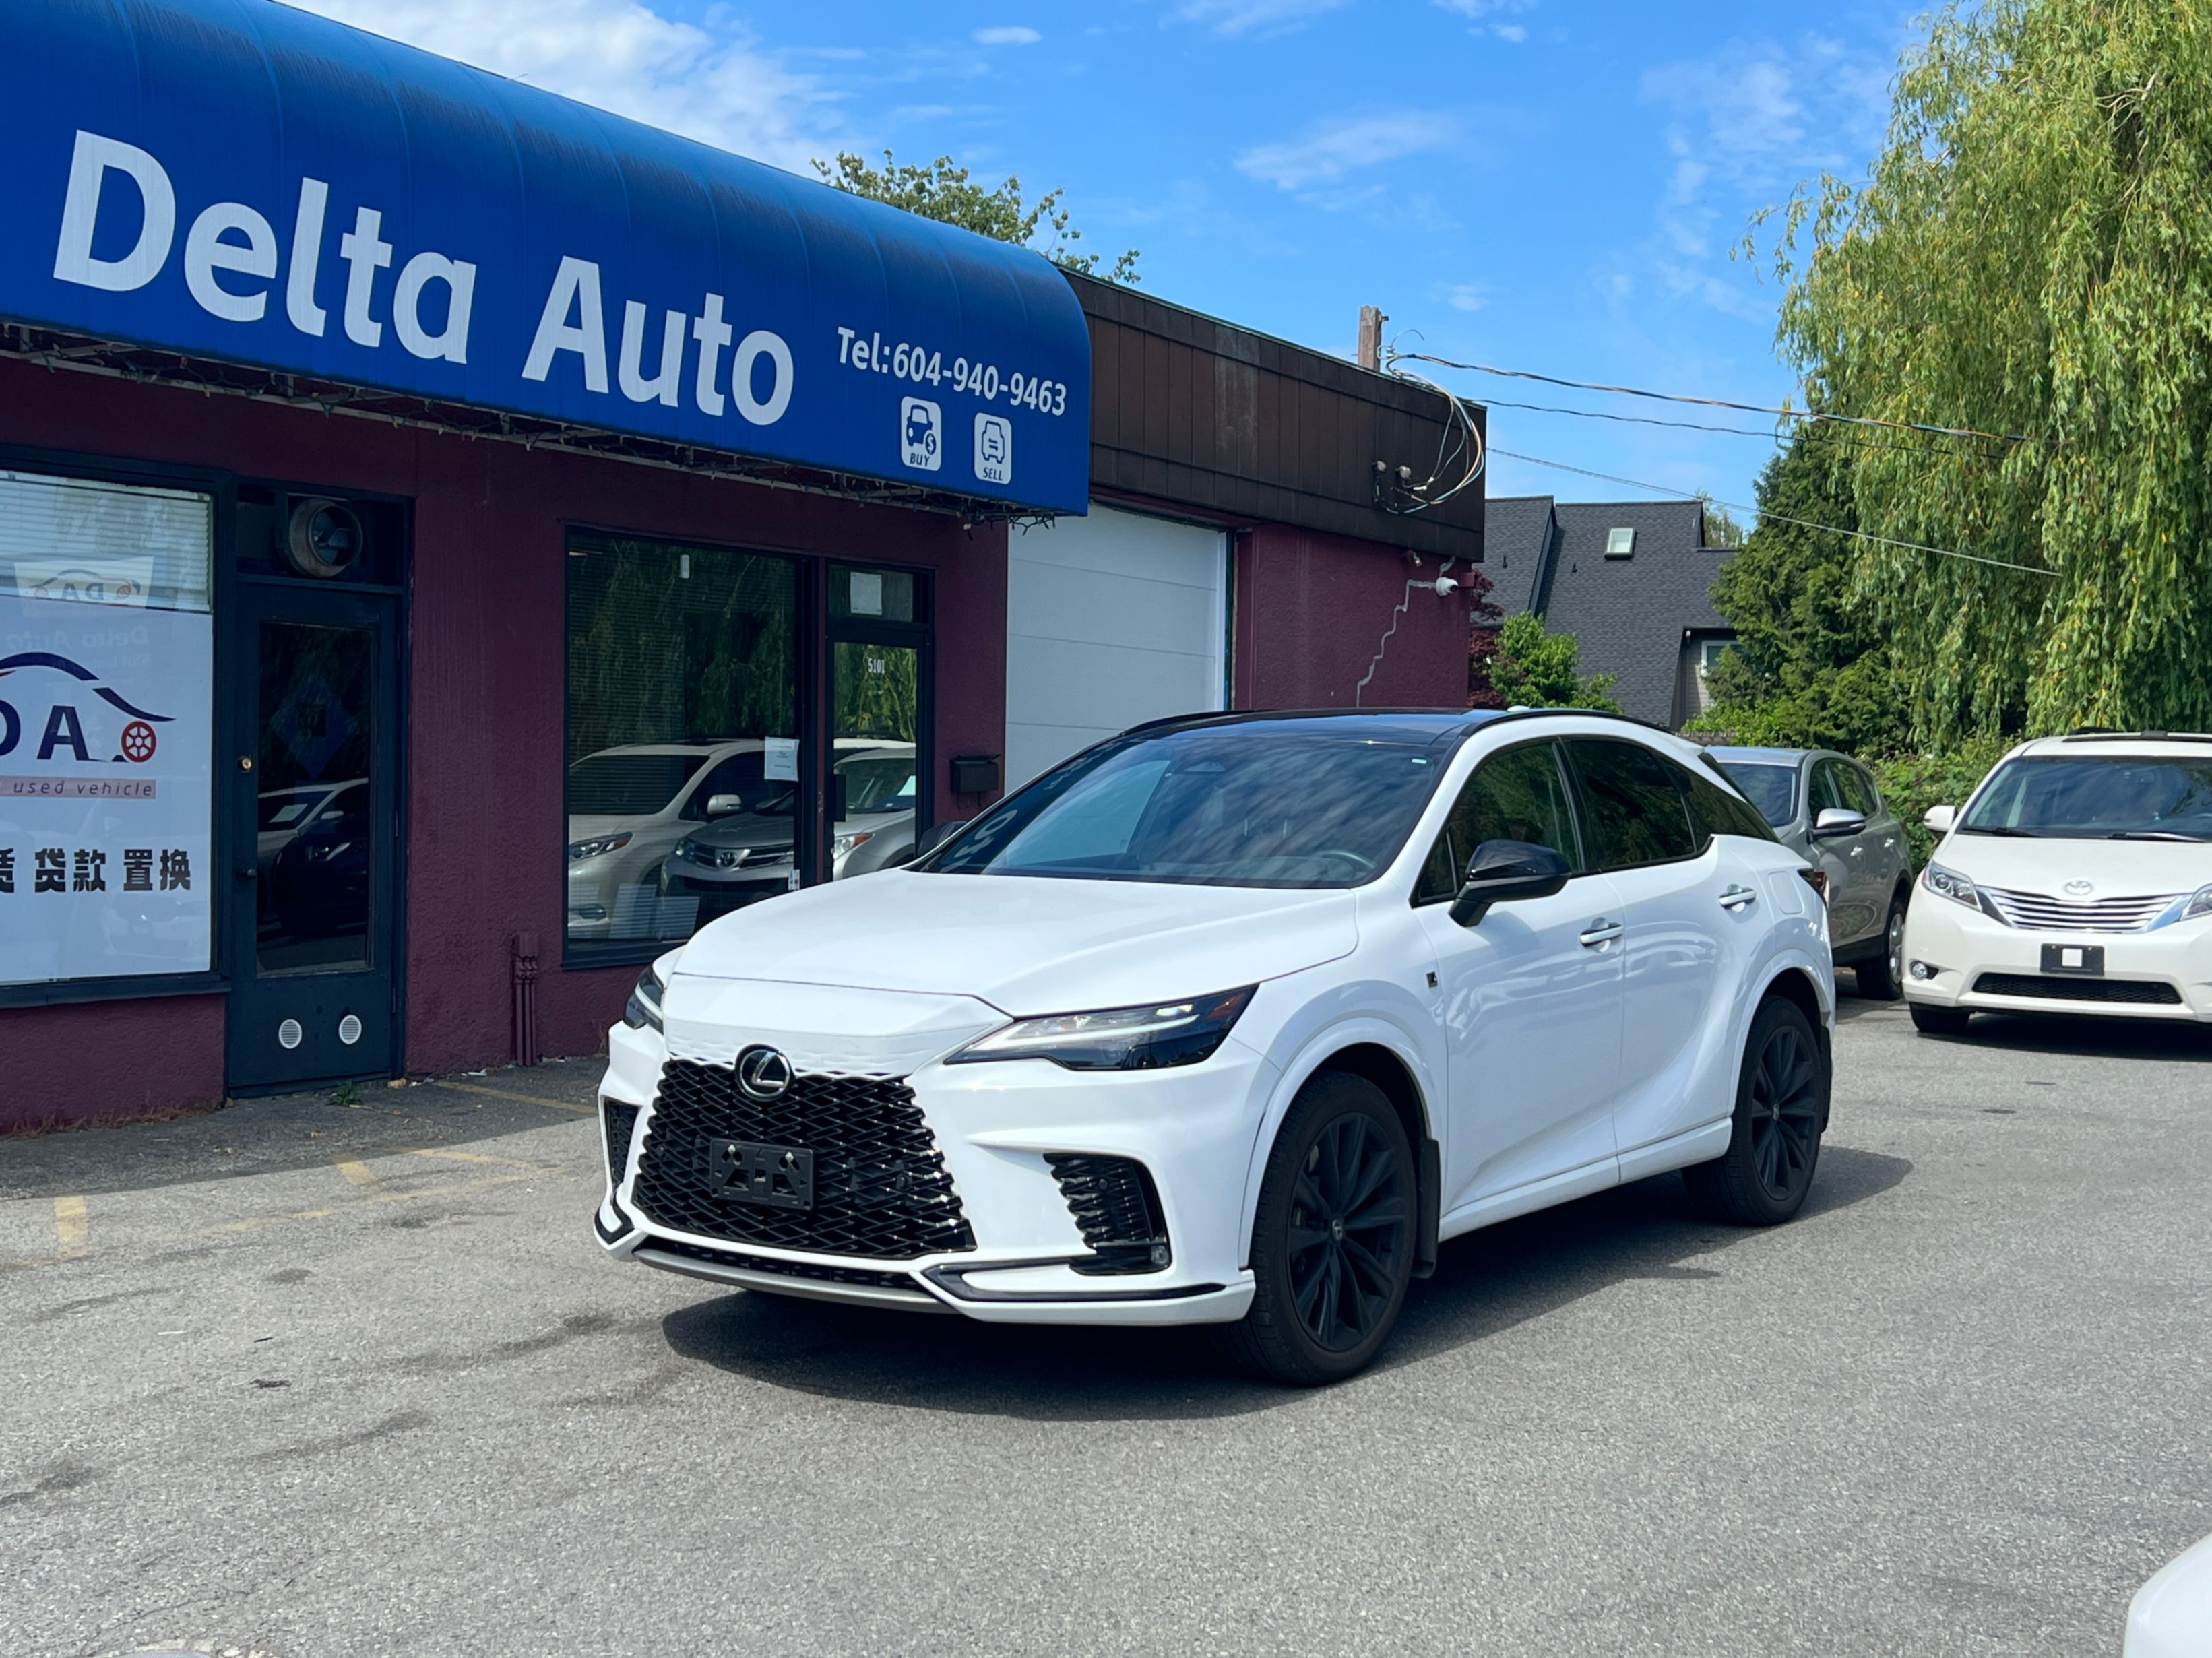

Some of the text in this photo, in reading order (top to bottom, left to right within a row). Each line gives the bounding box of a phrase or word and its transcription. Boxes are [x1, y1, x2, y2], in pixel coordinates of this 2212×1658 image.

[53, 130, 794, 426] Delta Auto
[837, 326, 1067, 417] Tel:604-940-9463
[910, 452, 930, 467] BUY
[982, 466, 1003, 482] SELL
[867, 658, 885, 674] 5101
[13, 779, 153, 796] used vehicle
[34, 848, 106, 893] 贷款
[123, 848, 192, 891] 置换
